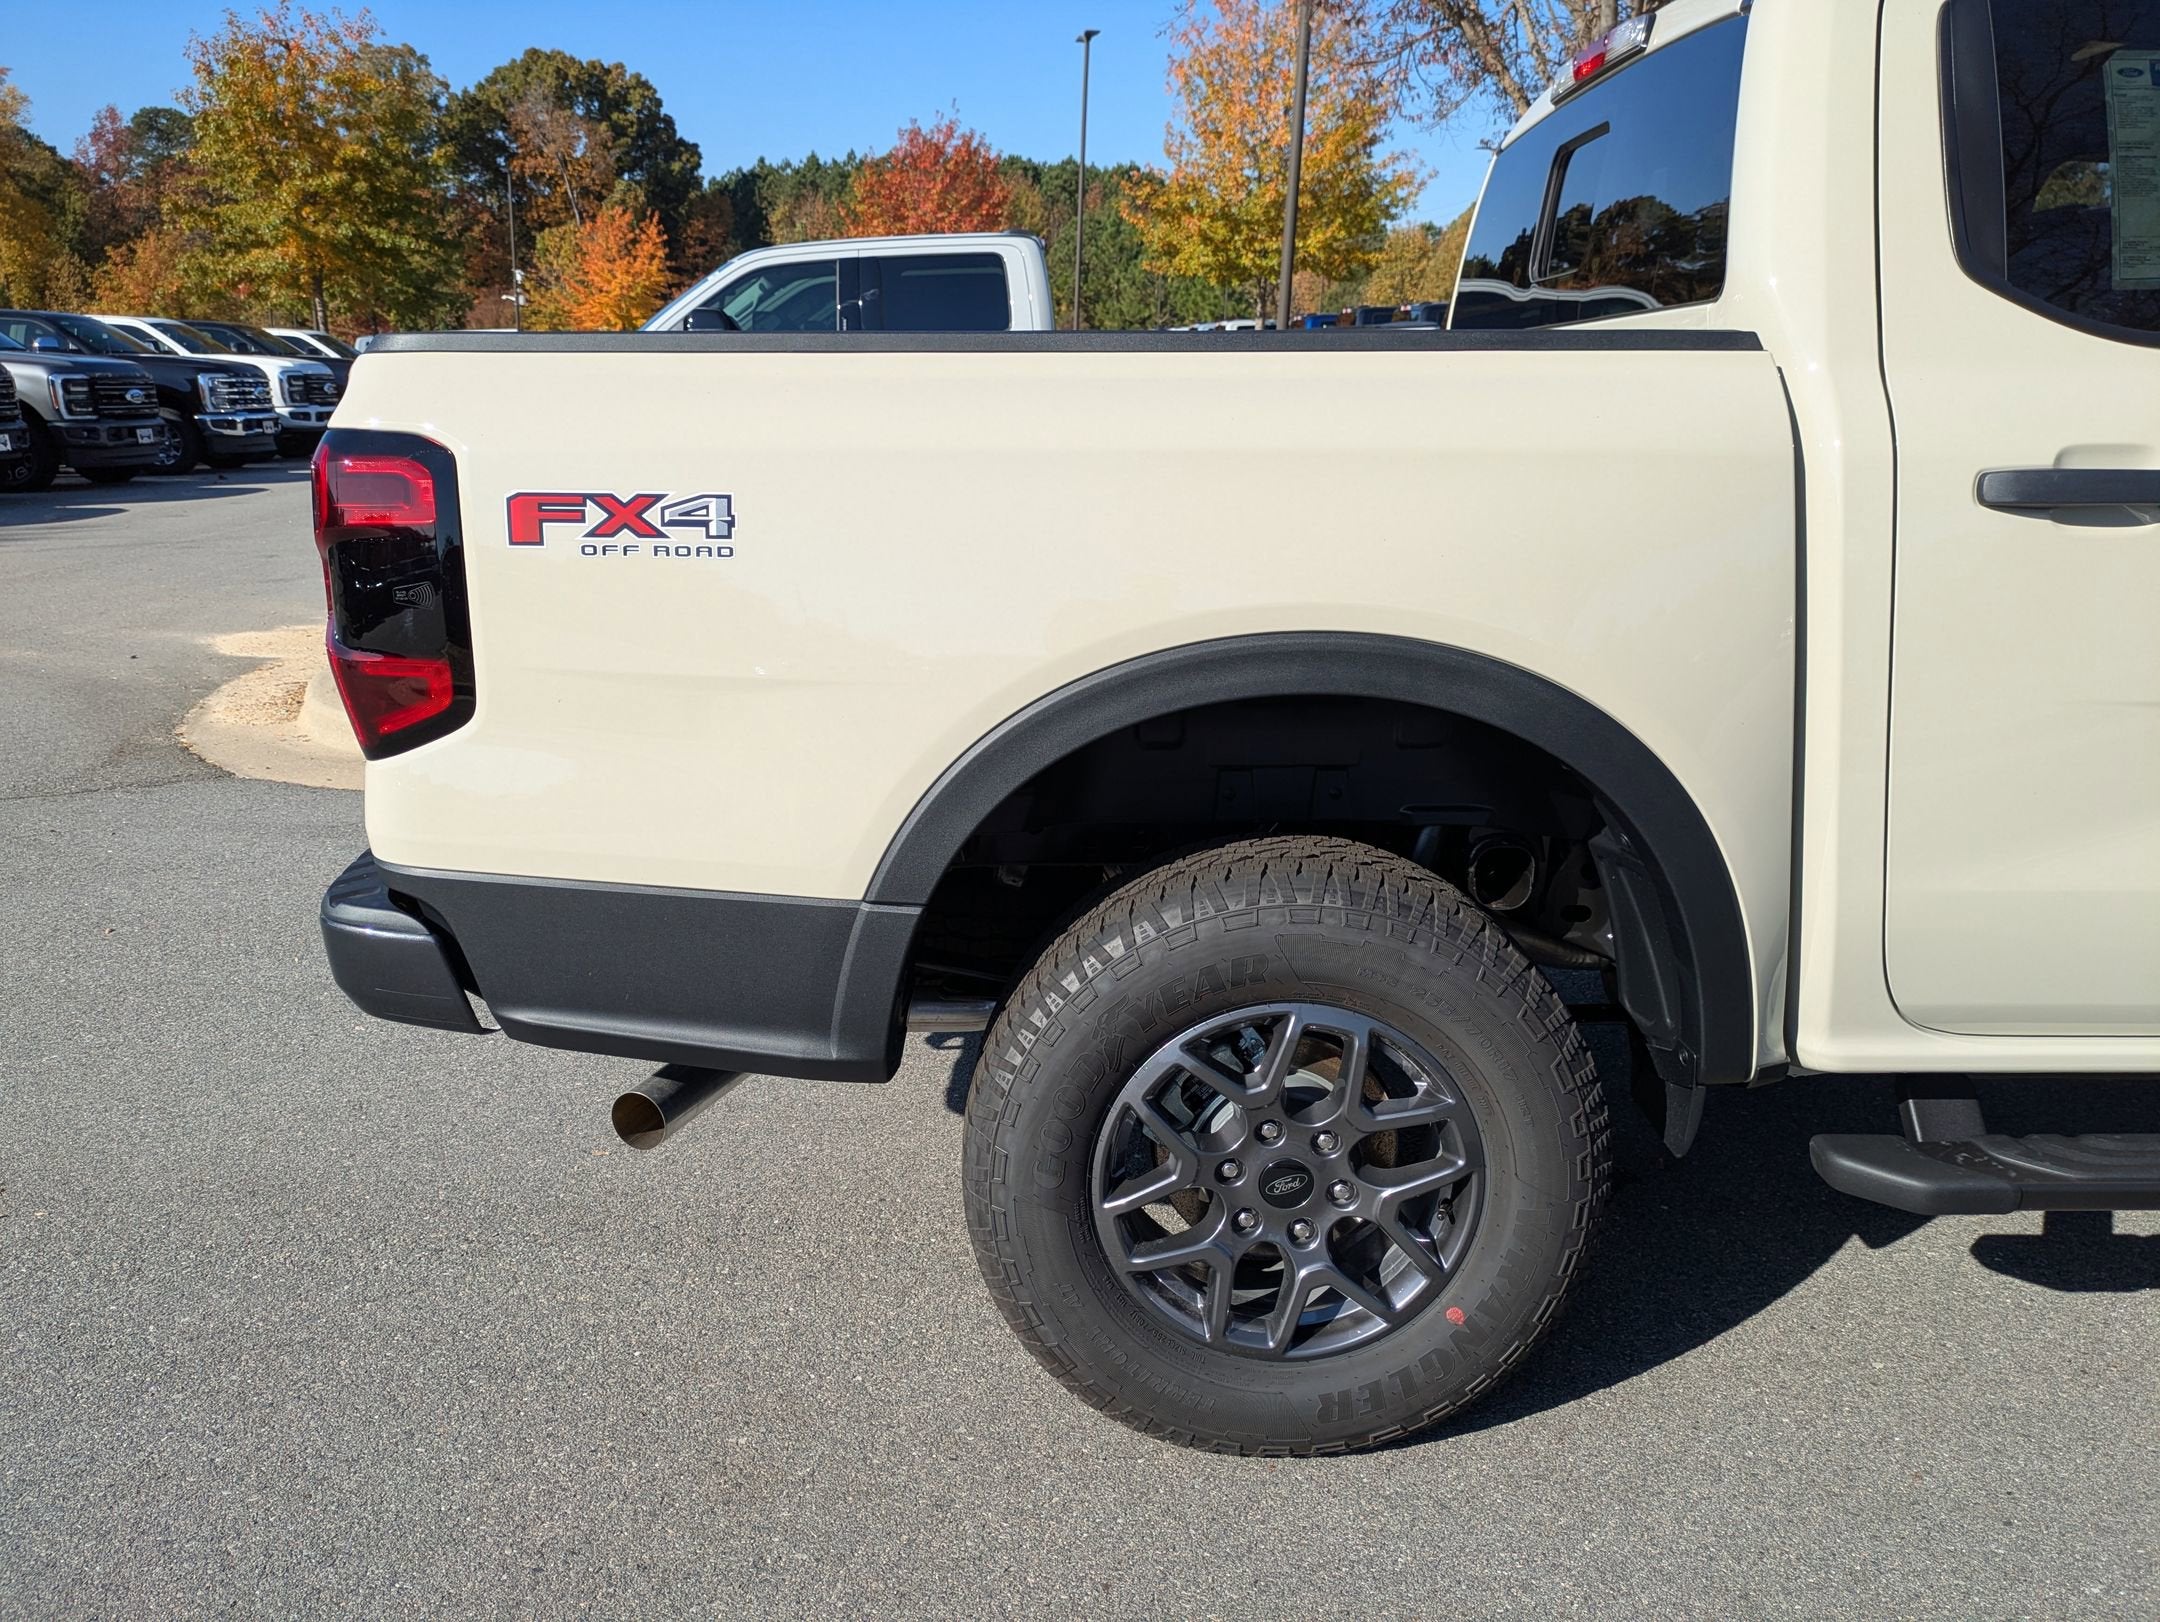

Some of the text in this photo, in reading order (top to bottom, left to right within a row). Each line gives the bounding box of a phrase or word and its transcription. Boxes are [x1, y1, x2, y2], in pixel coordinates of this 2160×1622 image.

[505, 491, 736, 548] FX4
[580, 543, 735, 559] OFF ROAD
[1273, 1177, 1300, 1194] Ford
[1315, 1208, 1553, 1426] WRANGLER
